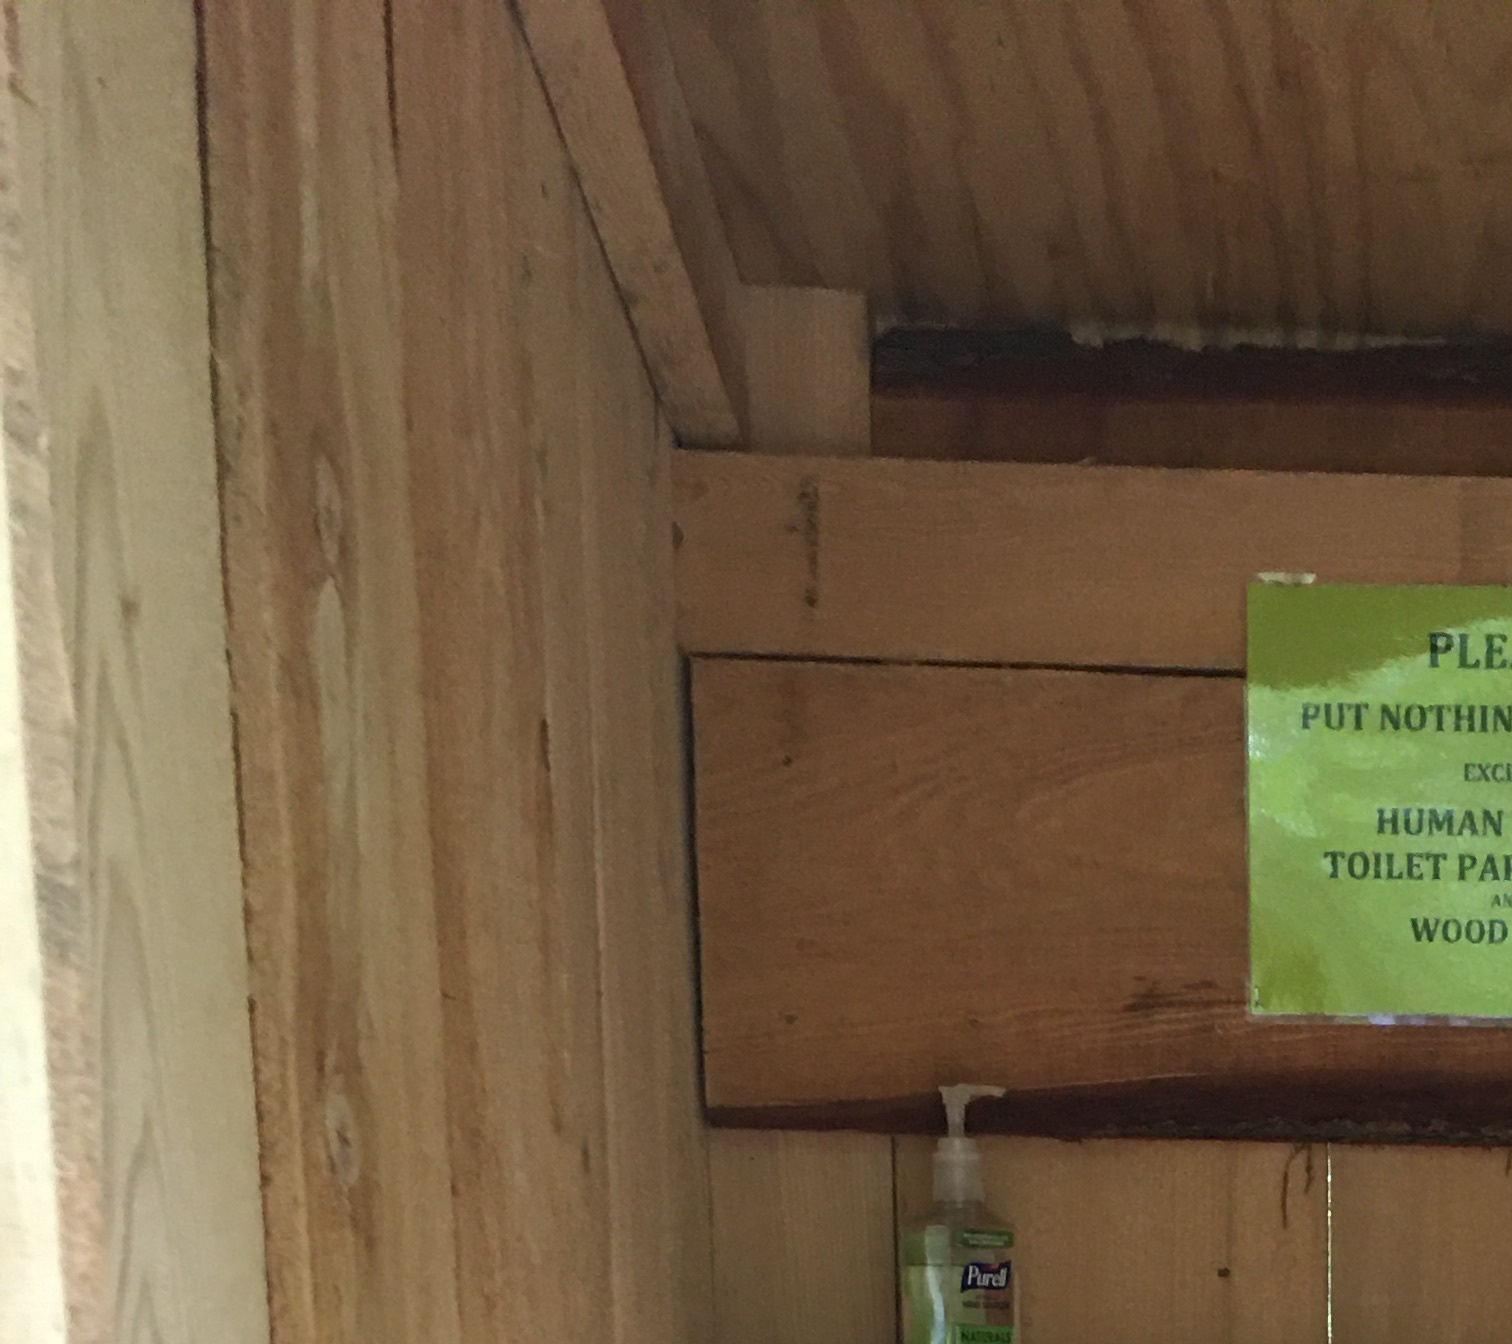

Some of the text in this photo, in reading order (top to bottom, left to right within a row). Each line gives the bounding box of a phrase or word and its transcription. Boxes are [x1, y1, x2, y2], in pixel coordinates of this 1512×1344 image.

[1301, 702, 1369, 731] PUT
[1376, 808, 1503, 837] HUMAN
[1324, 851, 1447, 881] TOILET
[1410, 918, 1508, 944] WOOD
[967, 1265, 1008, 1287] Purell
